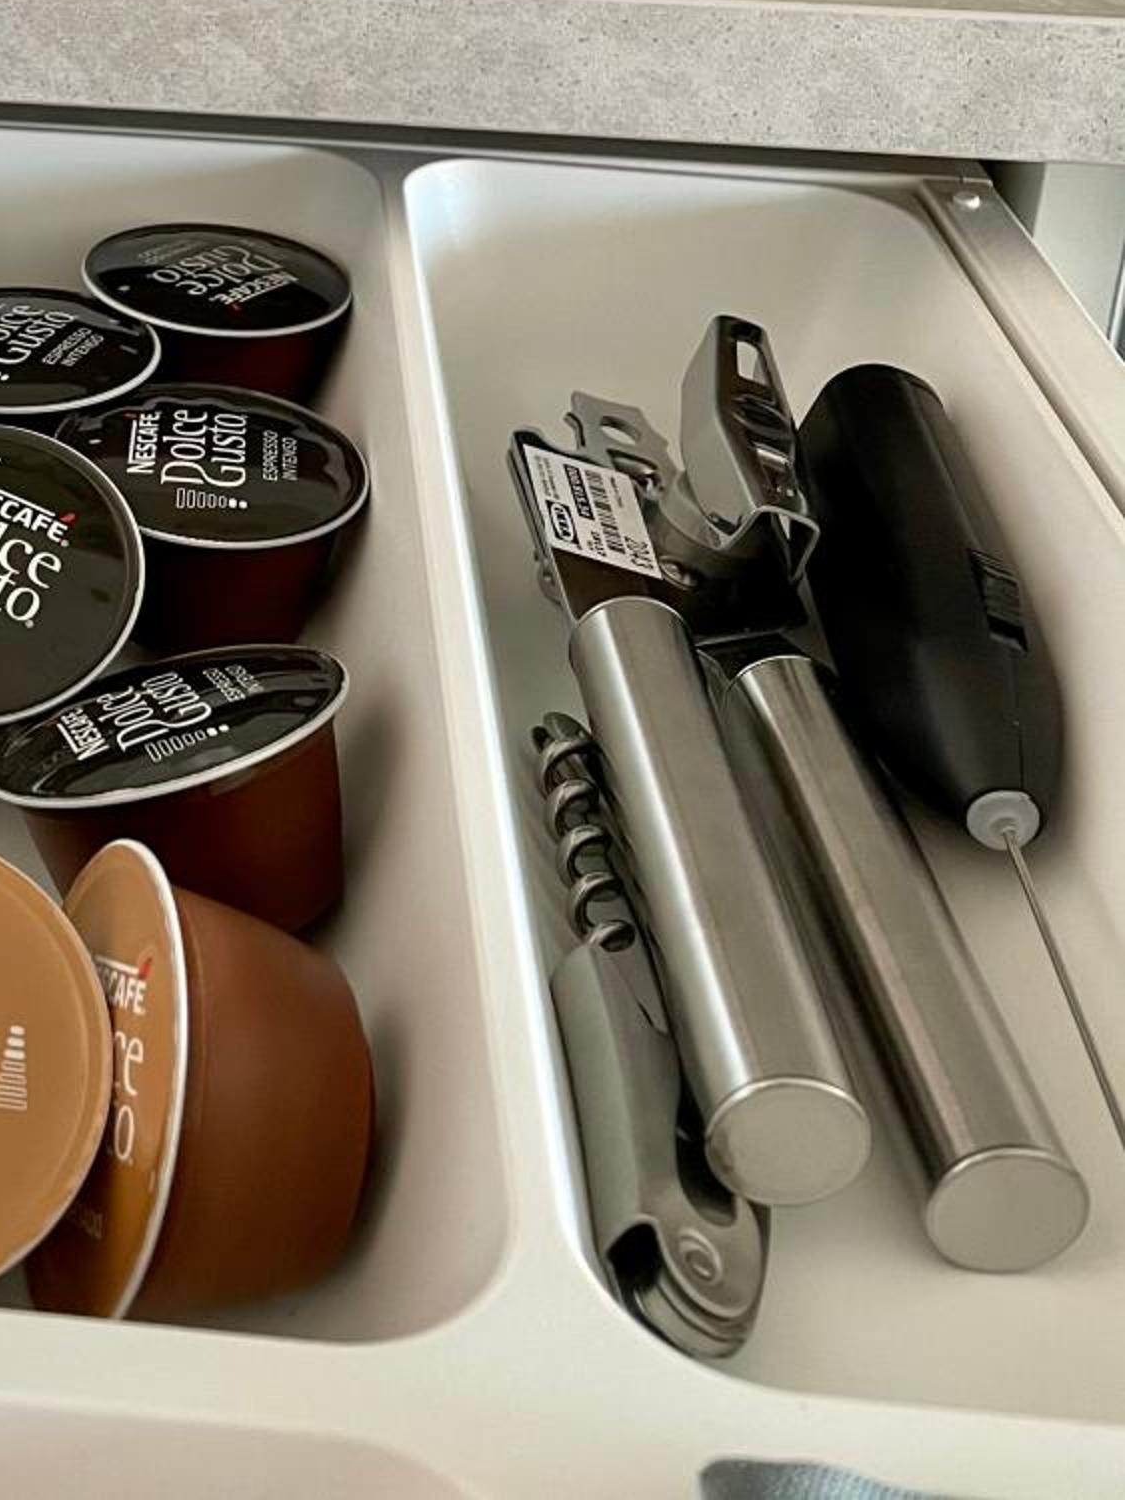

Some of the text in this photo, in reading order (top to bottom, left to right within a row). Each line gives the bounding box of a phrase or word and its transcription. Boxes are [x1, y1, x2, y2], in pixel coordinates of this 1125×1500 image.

[152, 245, 250, 283] Gusto
[176, 254, 285, 295] Dolce
[160, 409, 208, 484] Dolce
[201, 413, 248, 487] Gusto
[263, 430, 278, 481] ESPRESSO
[97, 686, 170, 751] Dolce
[141, 671, 213, 729] Gusto
